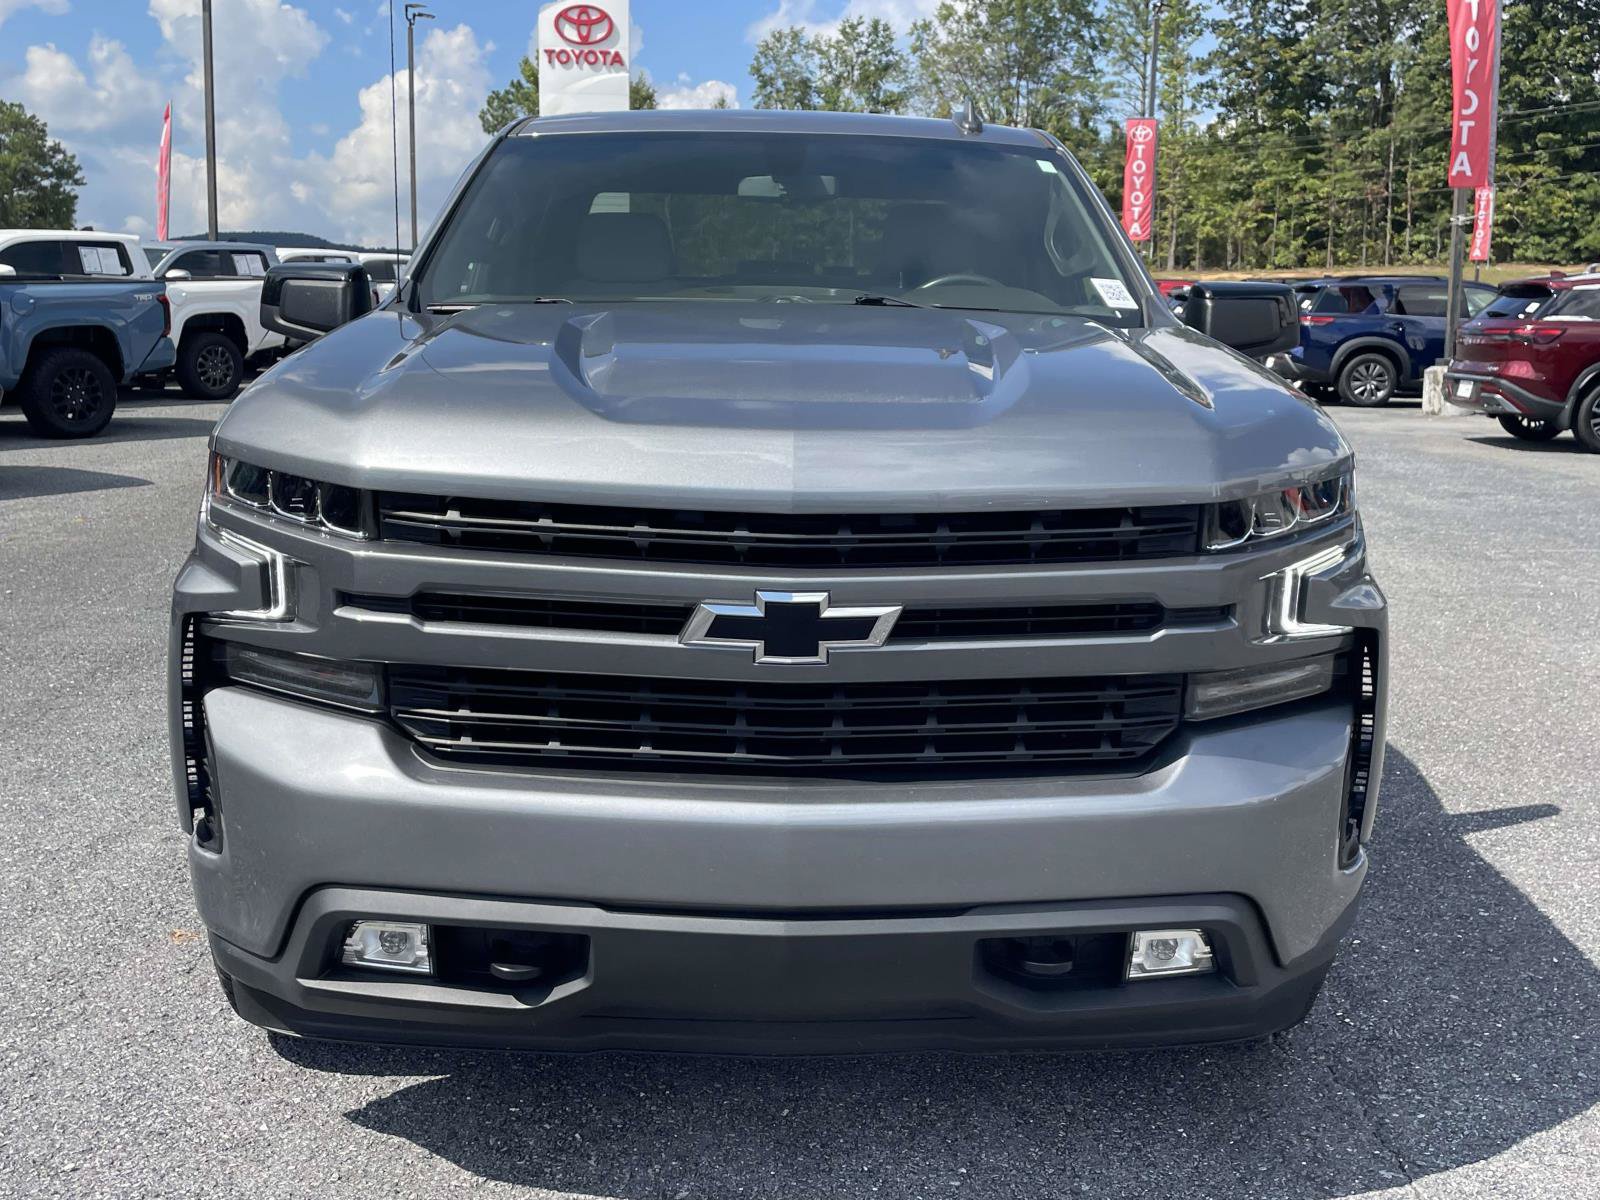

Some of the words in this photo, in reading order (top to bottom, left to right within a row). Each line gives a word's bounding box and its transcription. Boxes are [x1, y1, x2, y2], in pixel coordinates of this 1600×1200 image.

[544, 49, 624, 66] TOYOTA
[1451, 0, 1480, 177] TOYOTA
[1128, 144, 1146, 235] TOYOTA
[1472, 201, 1486, 257] TOYOTA
